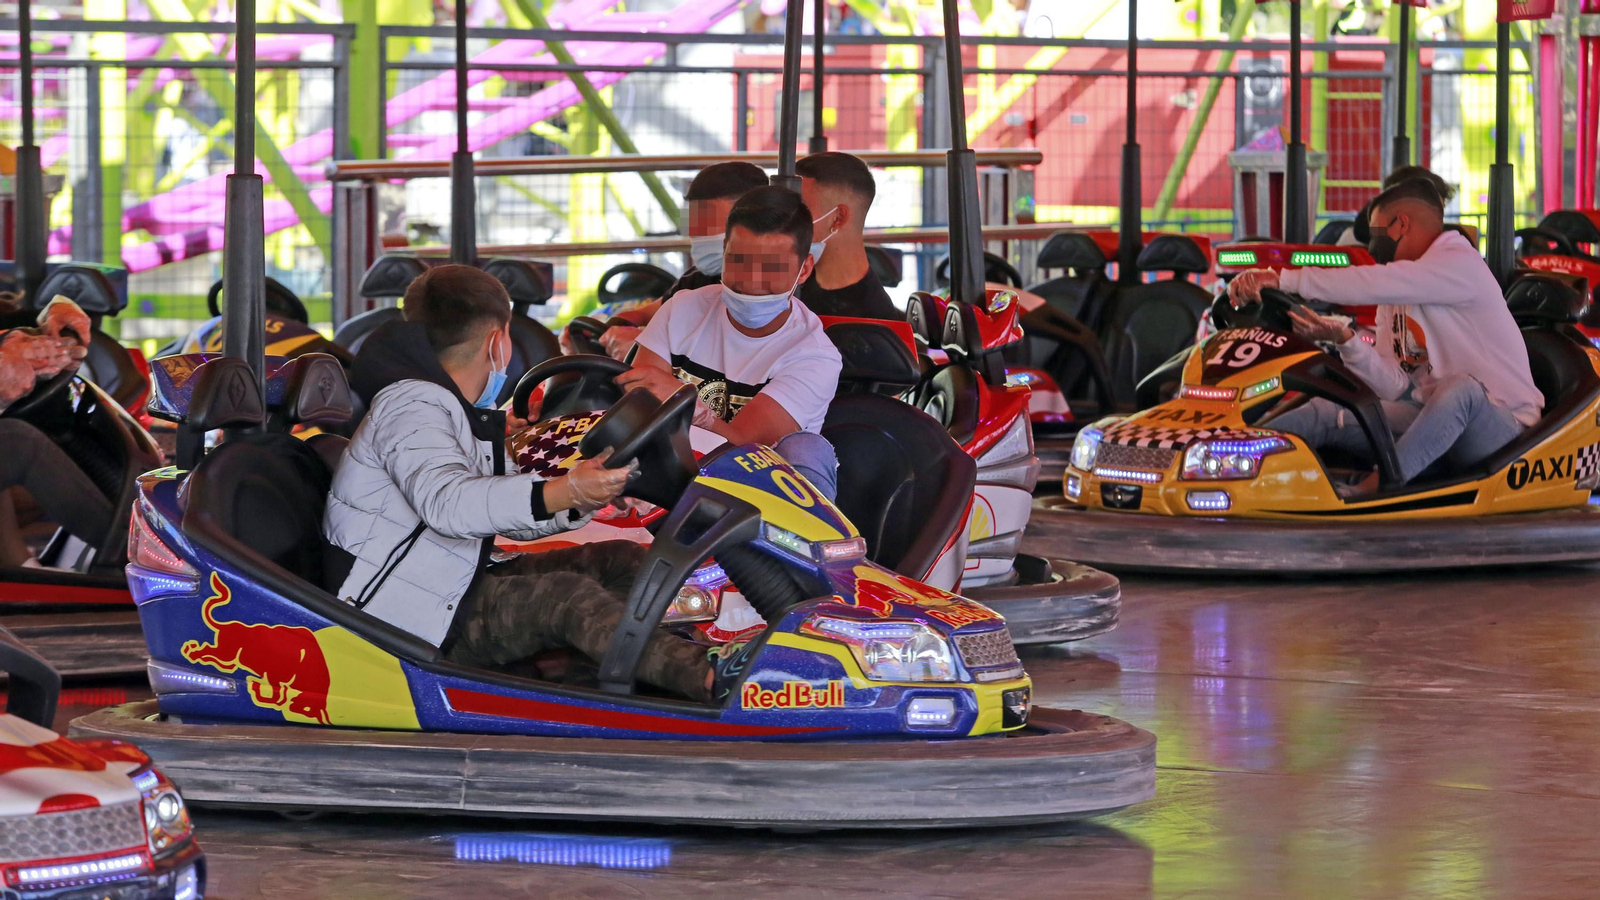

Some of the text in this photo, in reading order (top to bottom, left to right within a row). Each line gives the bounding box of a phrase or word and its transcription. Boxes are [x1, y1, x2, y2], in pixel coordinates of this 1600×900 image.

[1206, 341, 1261, 368] 19
[1144, 409, 1227, 424] TAXI
[1507, 455, 1573, 490] TAXI
[742, 680, 845, 708] Red Bull
